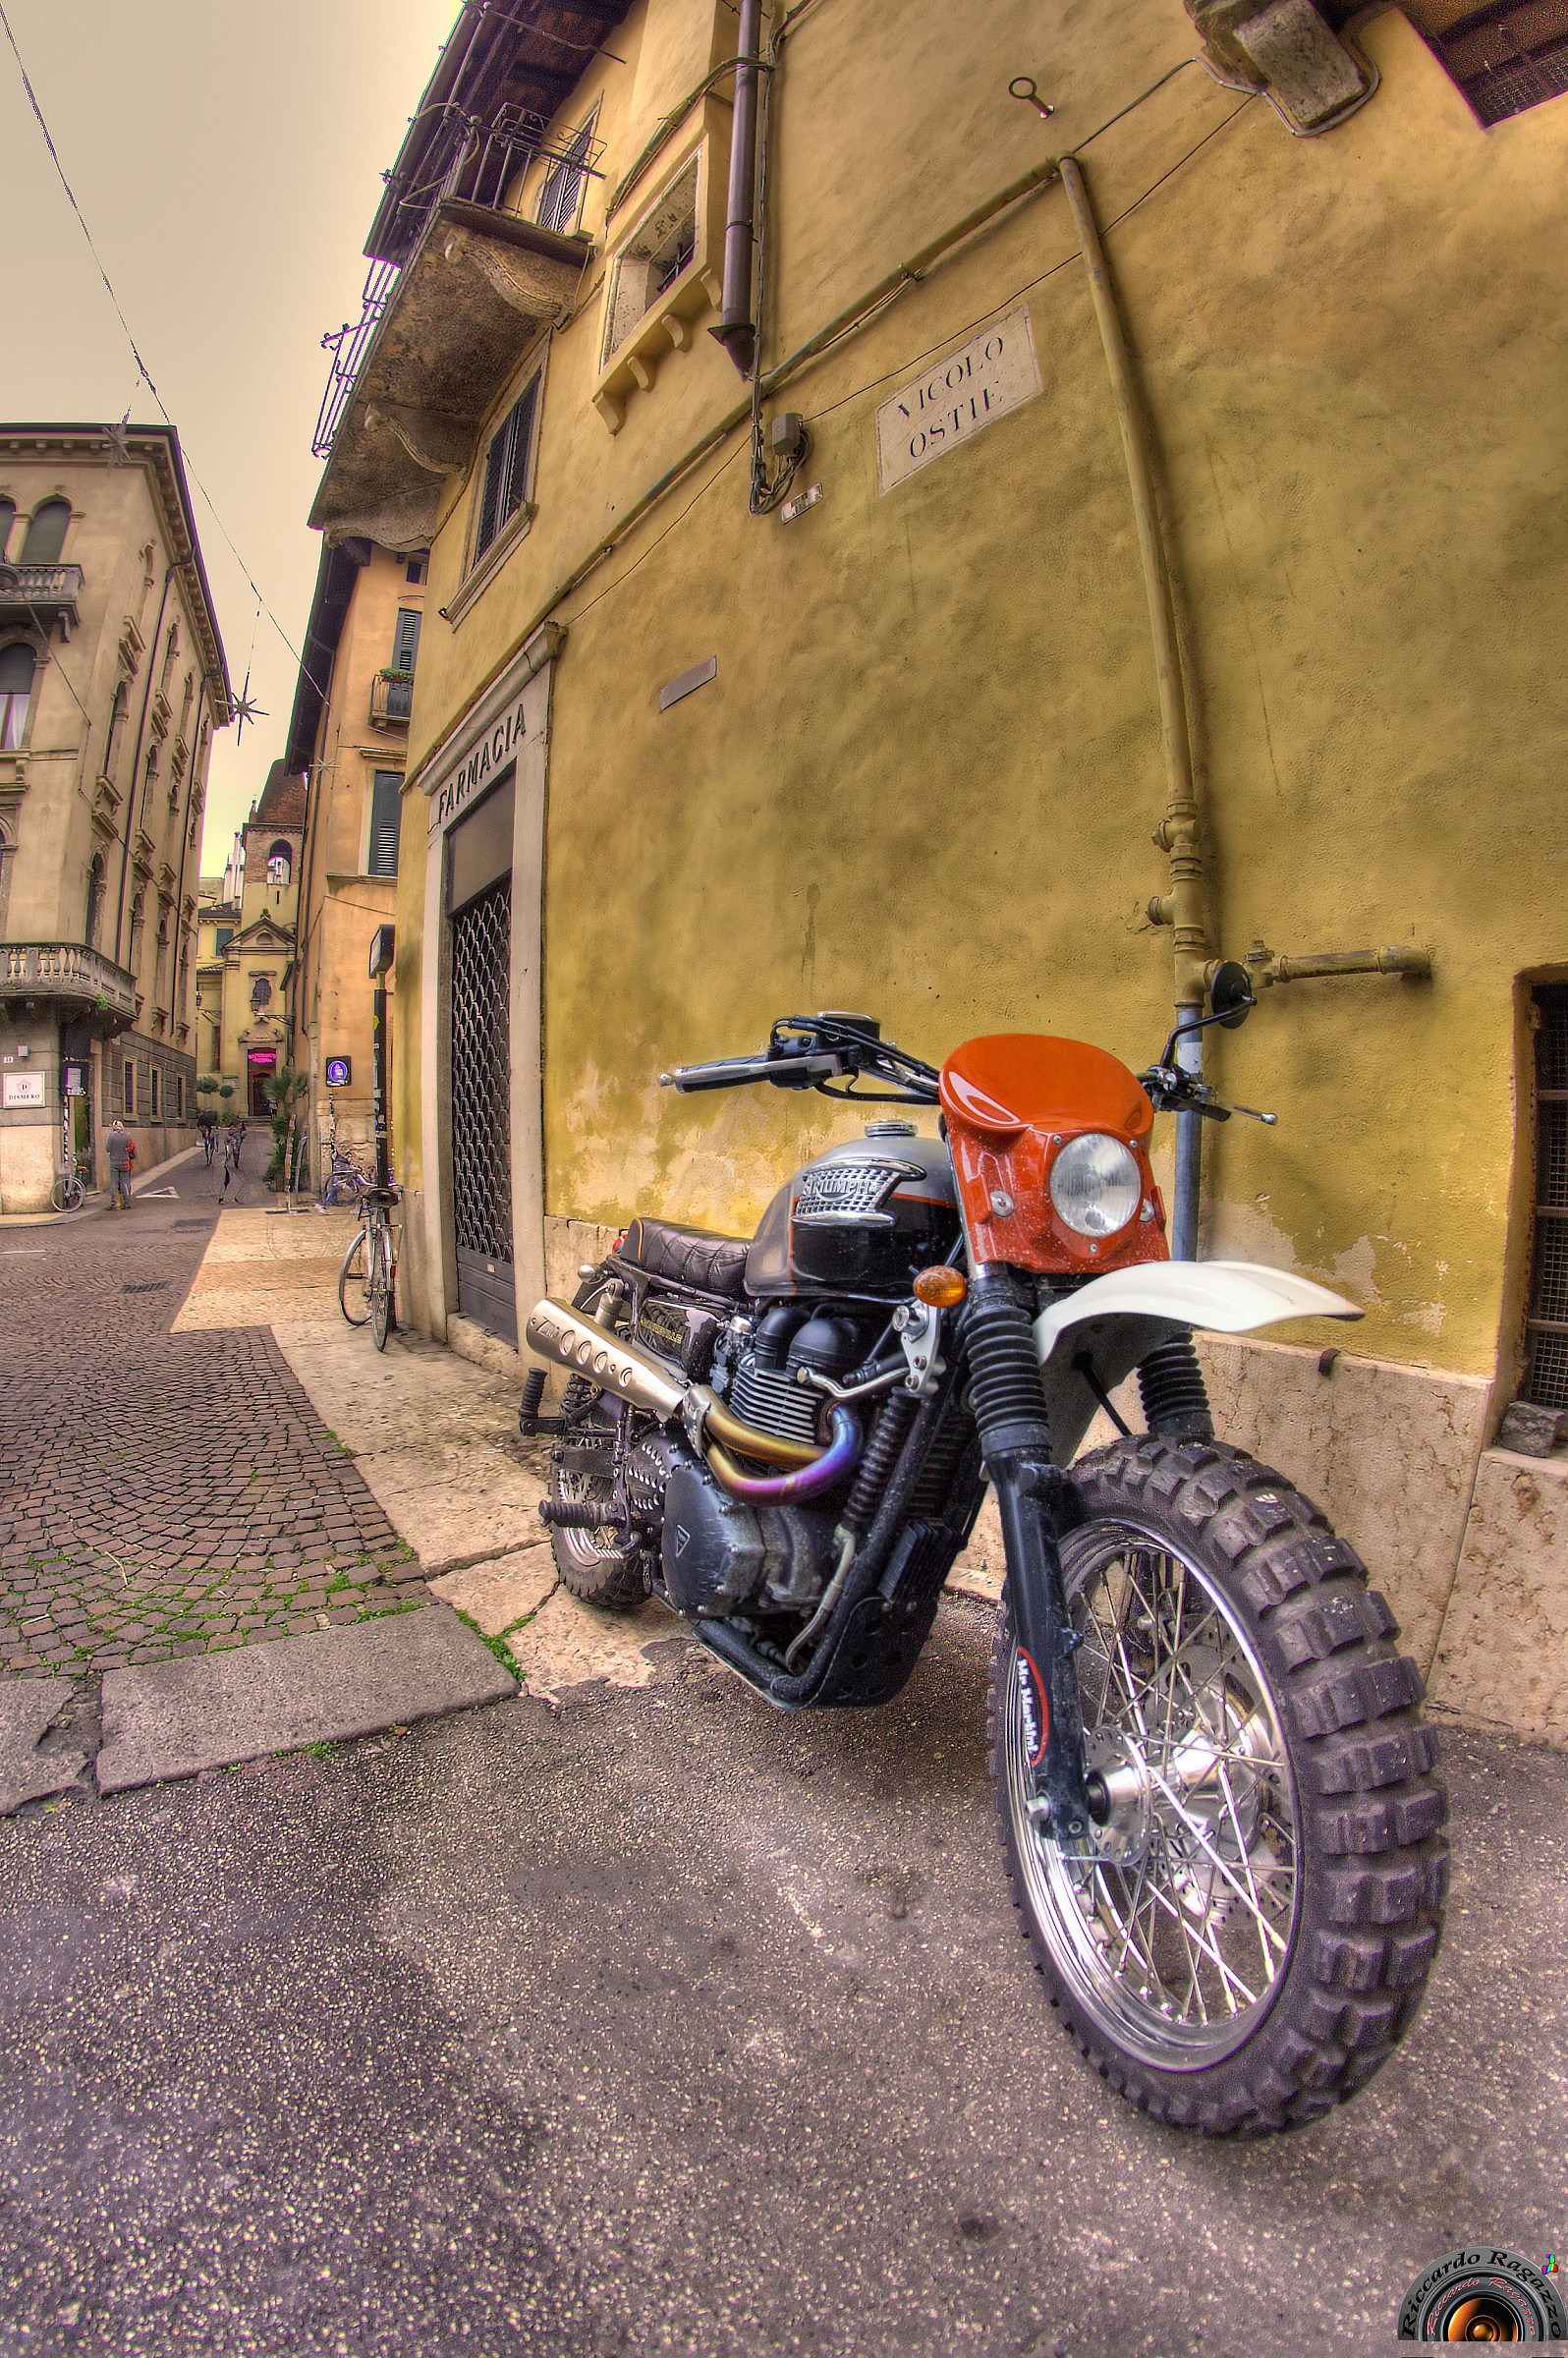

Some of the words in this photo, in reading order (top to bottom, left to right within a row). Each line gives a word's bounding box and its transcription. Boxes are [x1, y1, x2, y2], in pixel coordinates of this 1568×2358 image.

[897, 336, 1004, 420] VICOLO
[908, 380, 1003, 459] OSTIE
[437, 702, 527, 823] FARMACIA
[807, 1179, 869, 1198] TRIUMPH
[1017, 1658, 1031, 1689] Mr
